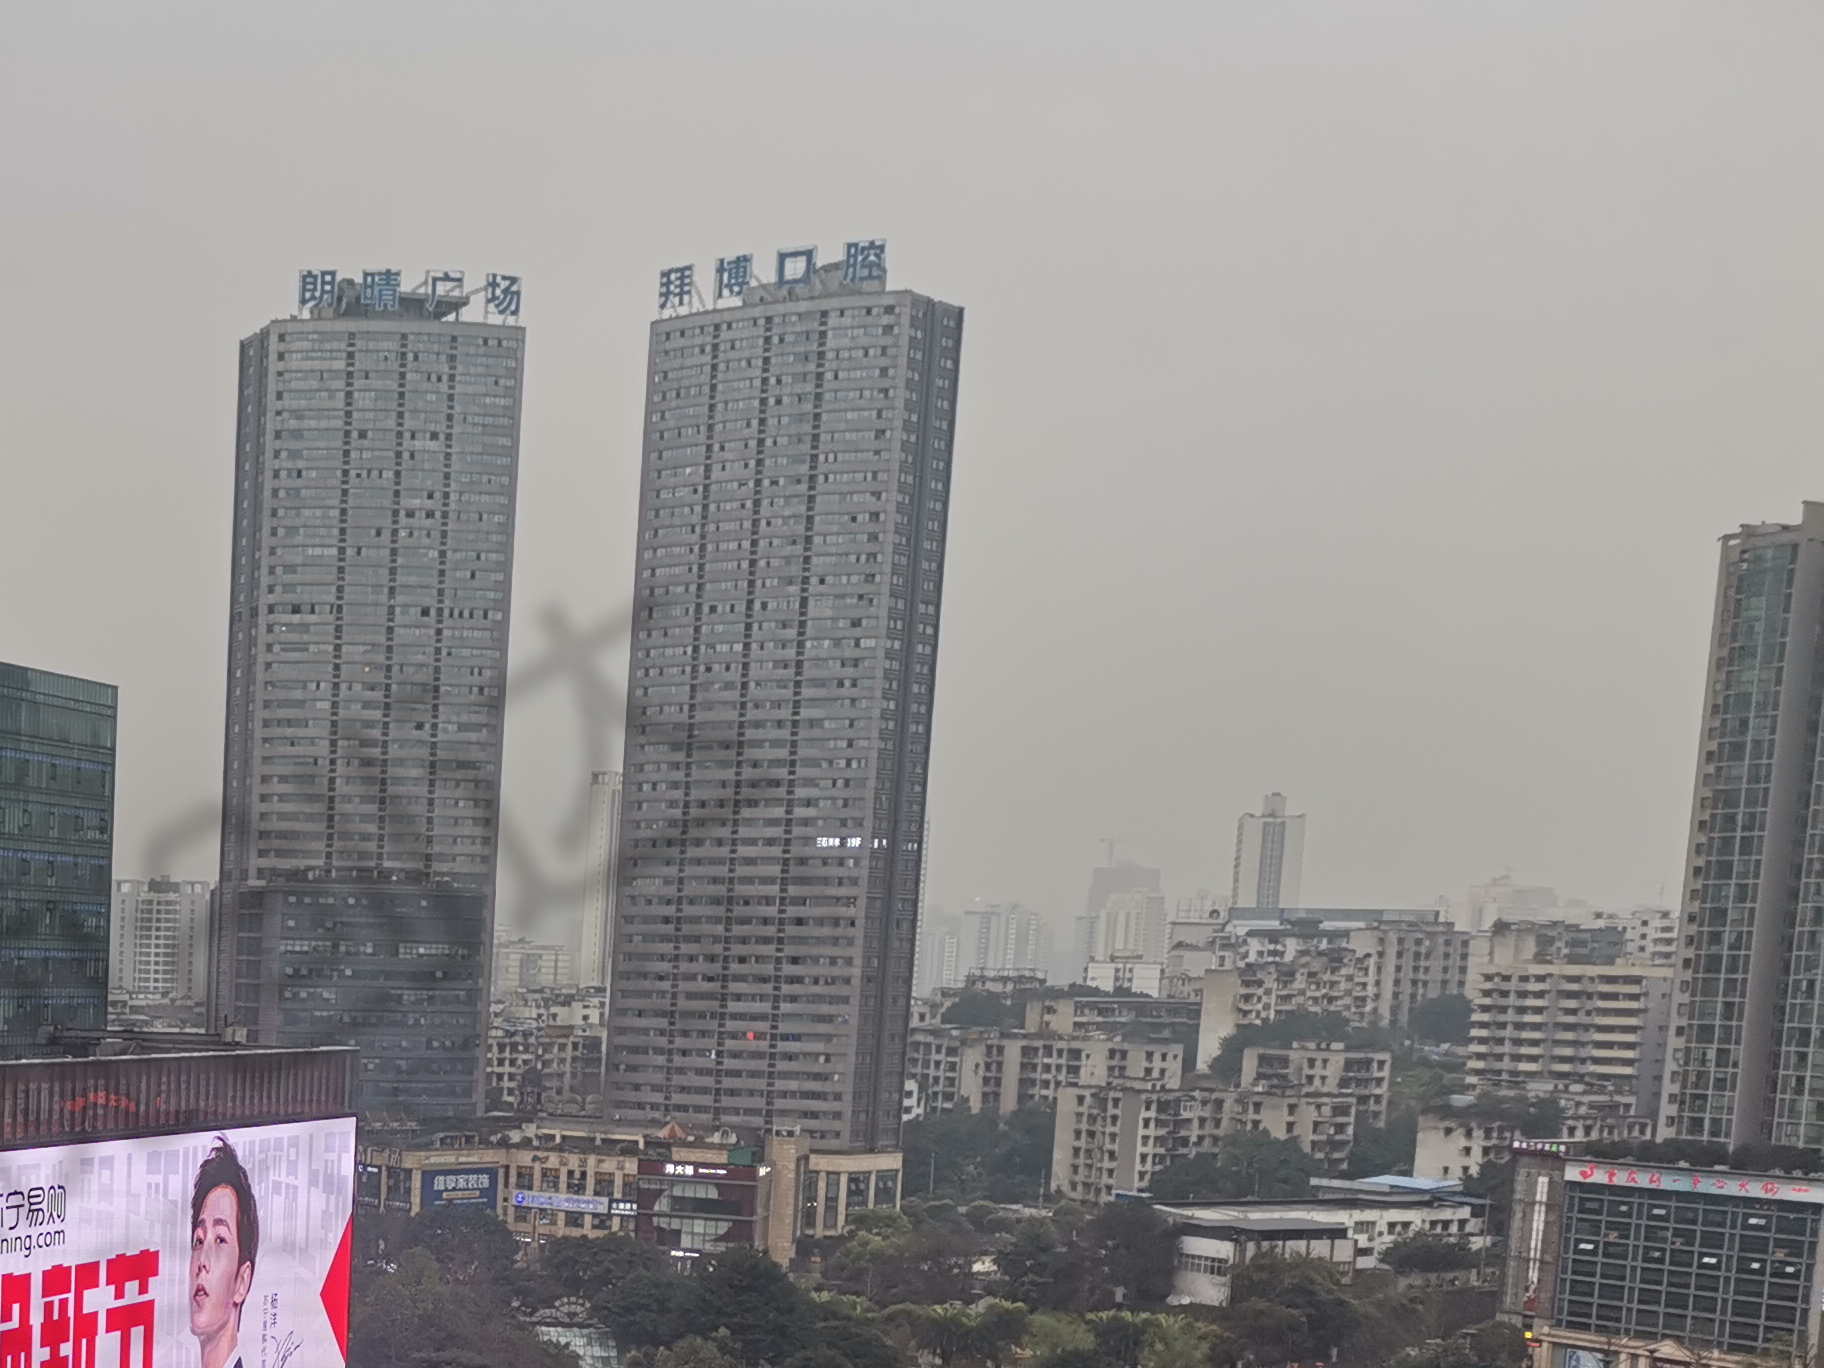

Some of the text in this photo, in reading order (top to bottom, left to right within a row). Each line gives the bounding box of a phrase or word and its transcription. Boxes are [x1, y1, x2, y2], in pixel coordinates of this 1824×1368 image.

[299, 268, 522, 316] 朗晴广场
[659, 239, 886, 310] 拜博口腔
